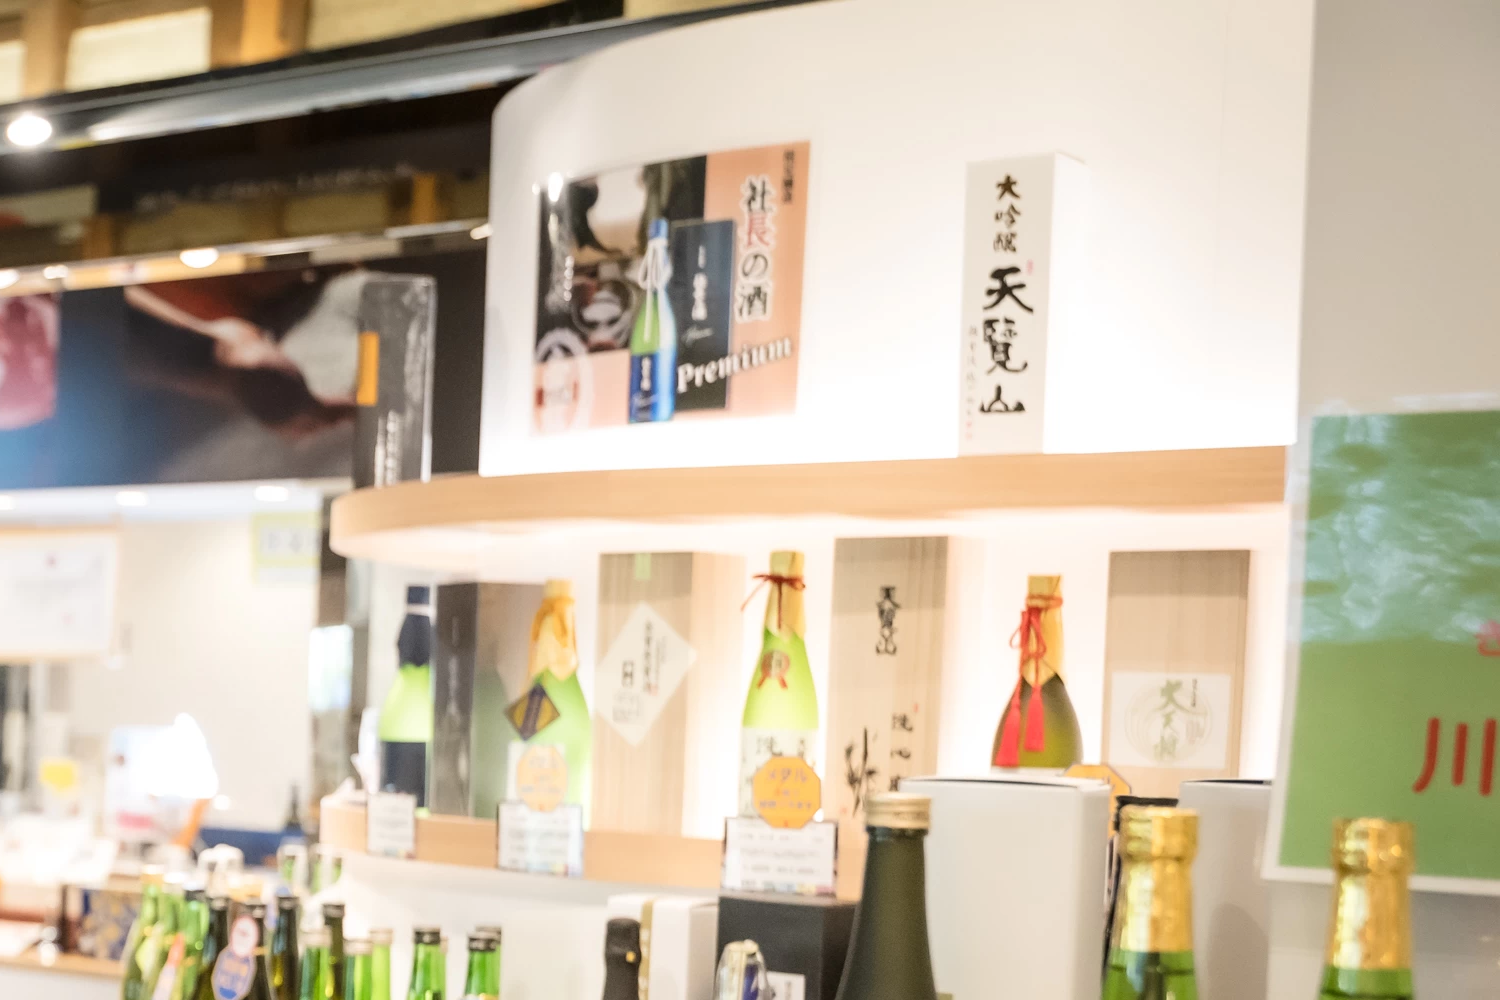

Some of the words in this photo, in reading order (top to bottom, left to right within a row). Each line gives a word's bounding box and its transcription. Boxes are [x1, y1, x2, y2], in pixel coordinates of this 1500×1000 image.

[736, 174, 774, 323] 社長の酒
[677, 337, 791, 393] Premium
